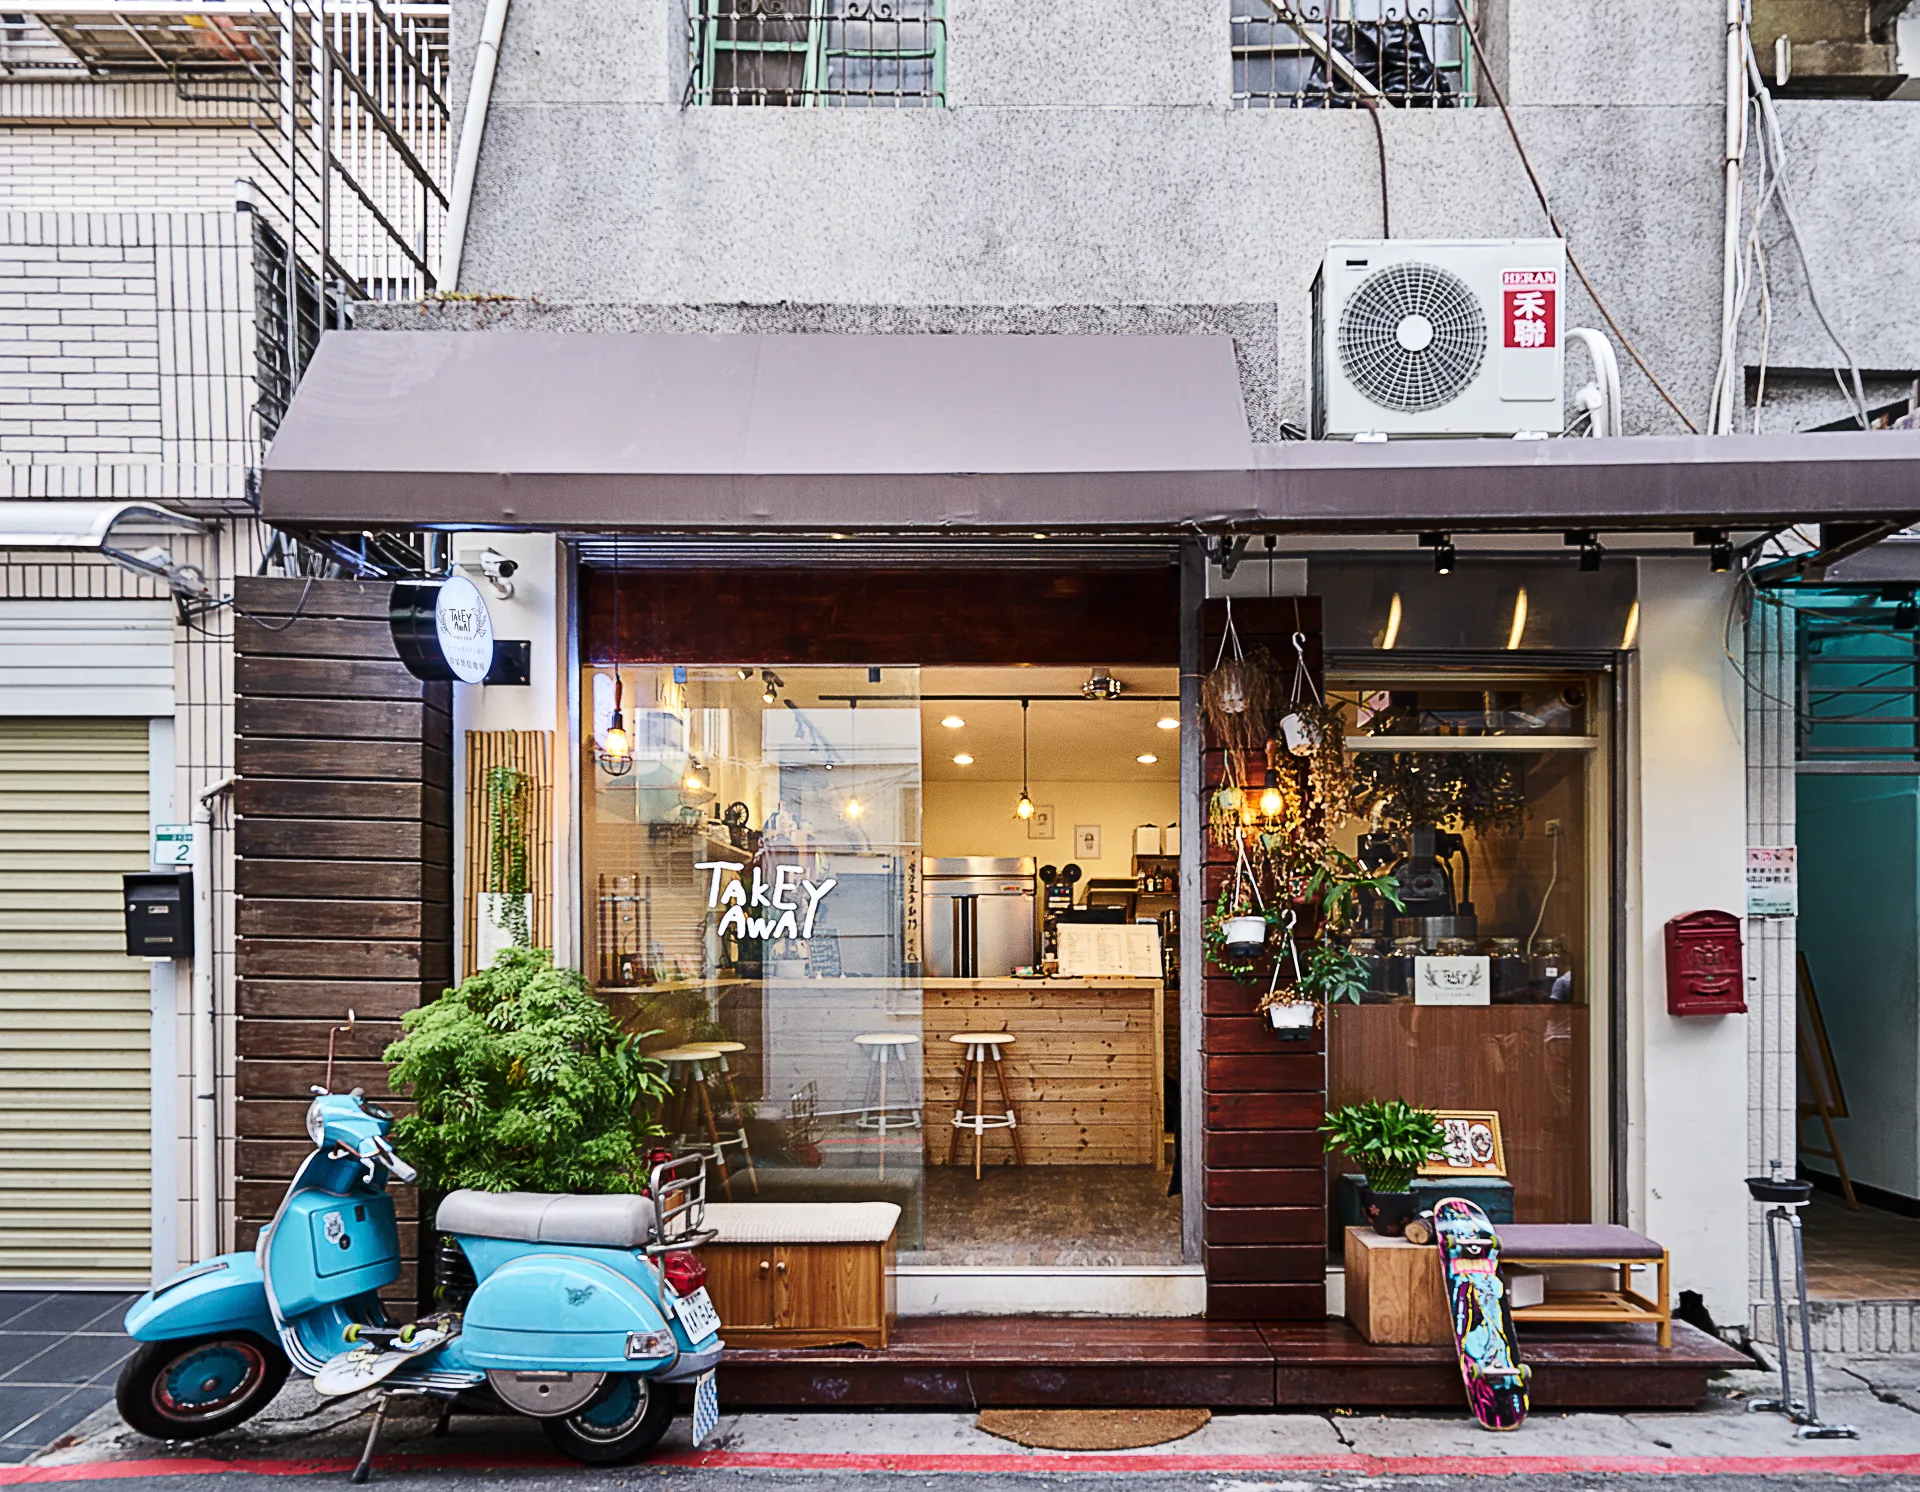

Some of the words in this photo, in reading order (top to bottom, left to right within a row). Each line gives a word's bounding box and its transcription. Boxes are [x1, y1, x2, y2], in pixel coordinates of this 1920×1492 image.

[1503, 272, 1554, 284] HERAN
[1513, 291, 1547, 347] 禾聯
[176, 844, 189, 860] 2
